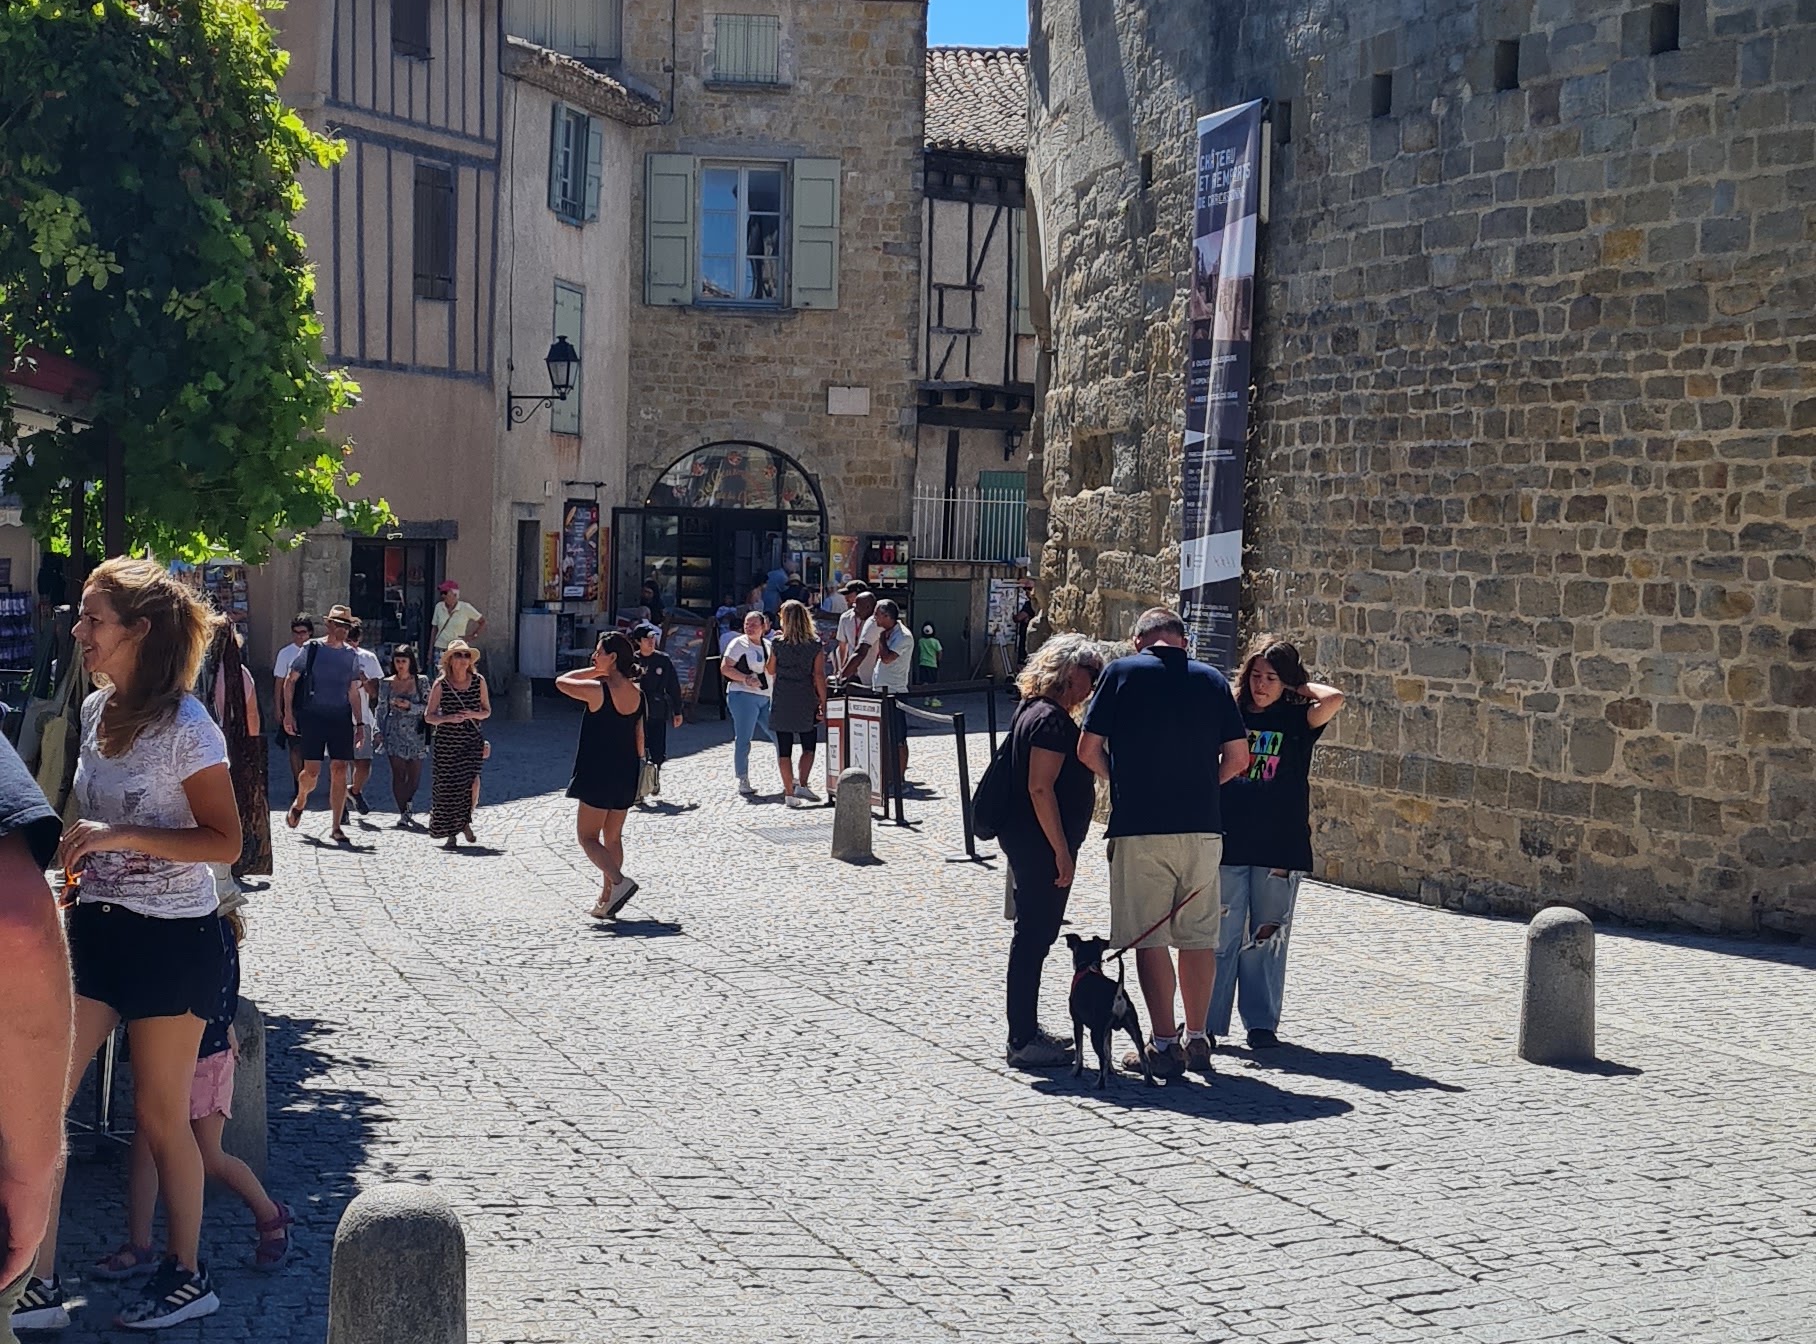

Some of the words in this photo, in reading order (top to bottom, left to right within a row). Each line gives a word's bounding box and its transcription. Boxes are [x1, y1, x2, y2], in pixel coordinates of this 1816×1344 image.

[1200, 147, 1236, 171] CHÂTEAU
[1199, 174, 1210, 192] ET
[1212, 162, 1251, 188] REMPARTS
[1197, 196, 1206, 210] DE
